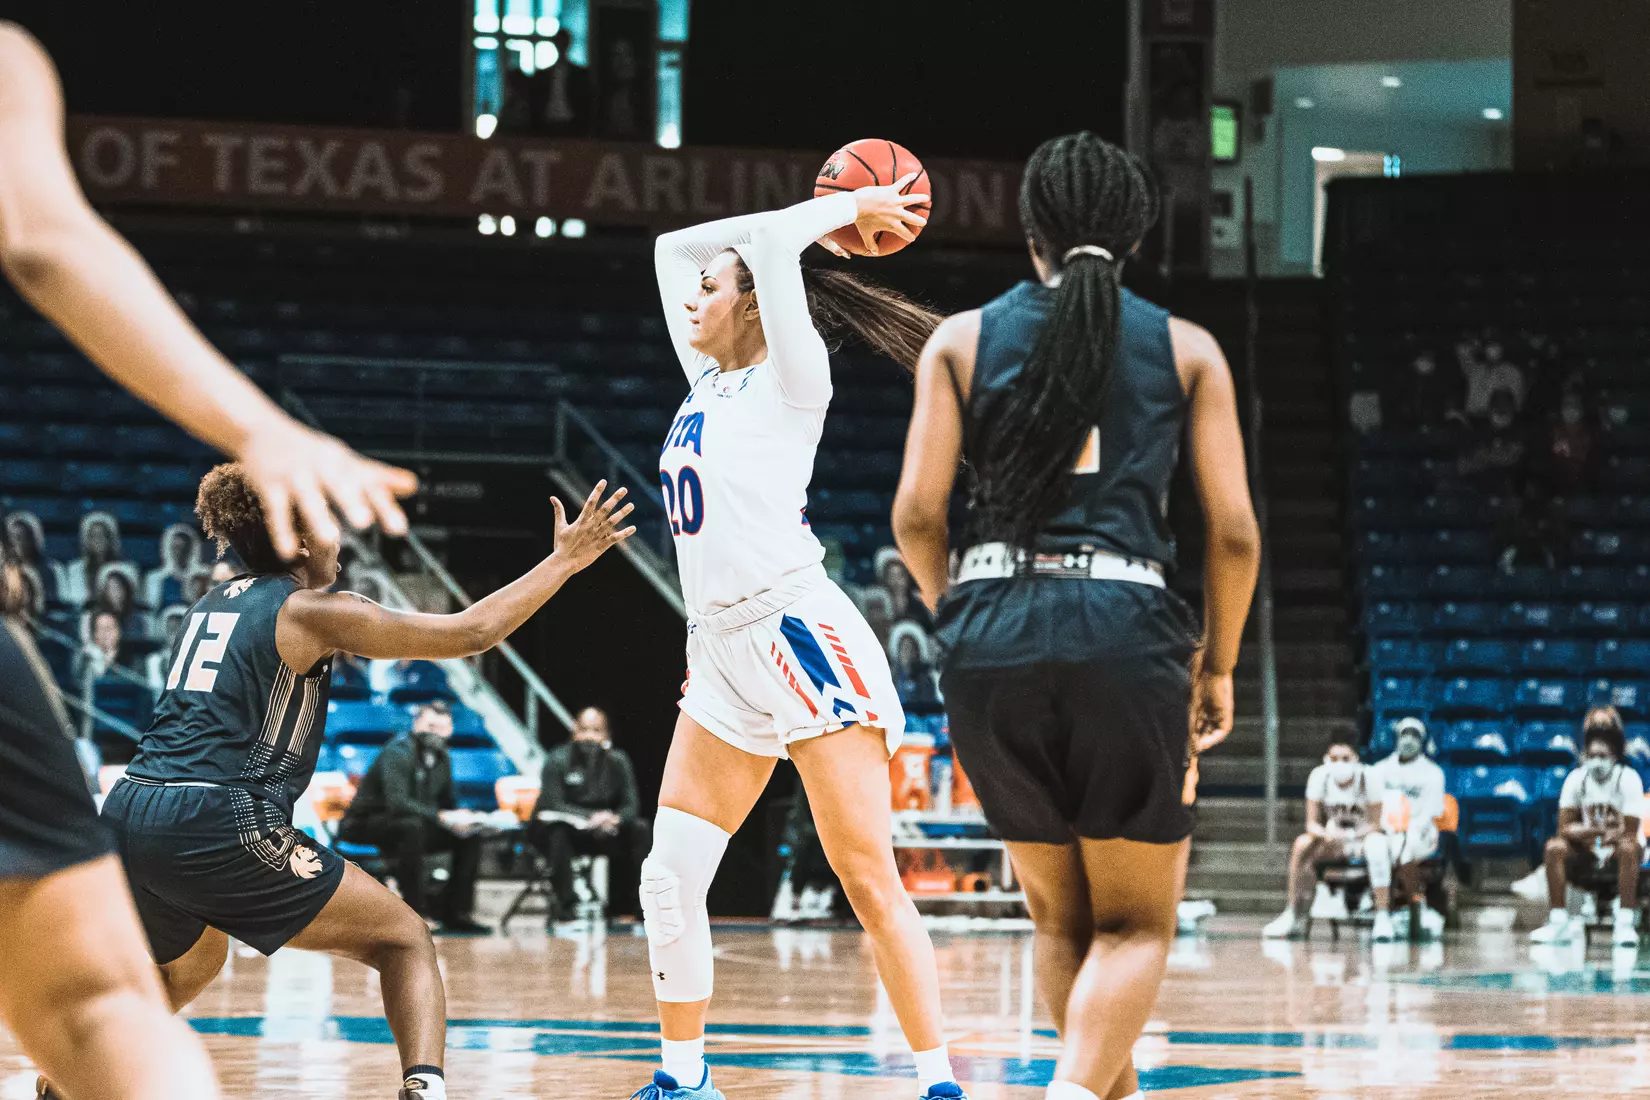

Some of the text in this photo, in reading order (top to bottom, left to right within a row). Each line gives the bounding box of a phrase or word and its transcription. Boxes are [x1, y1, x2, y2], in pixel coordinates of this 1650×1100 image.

[81, 127, 181, 189] OF
[203, 132, 445, 201] TEXAS
[469, 147, 562, 205] AT
[659, 465, 705, 536] 20
[166, 612, 241, 692] 12
